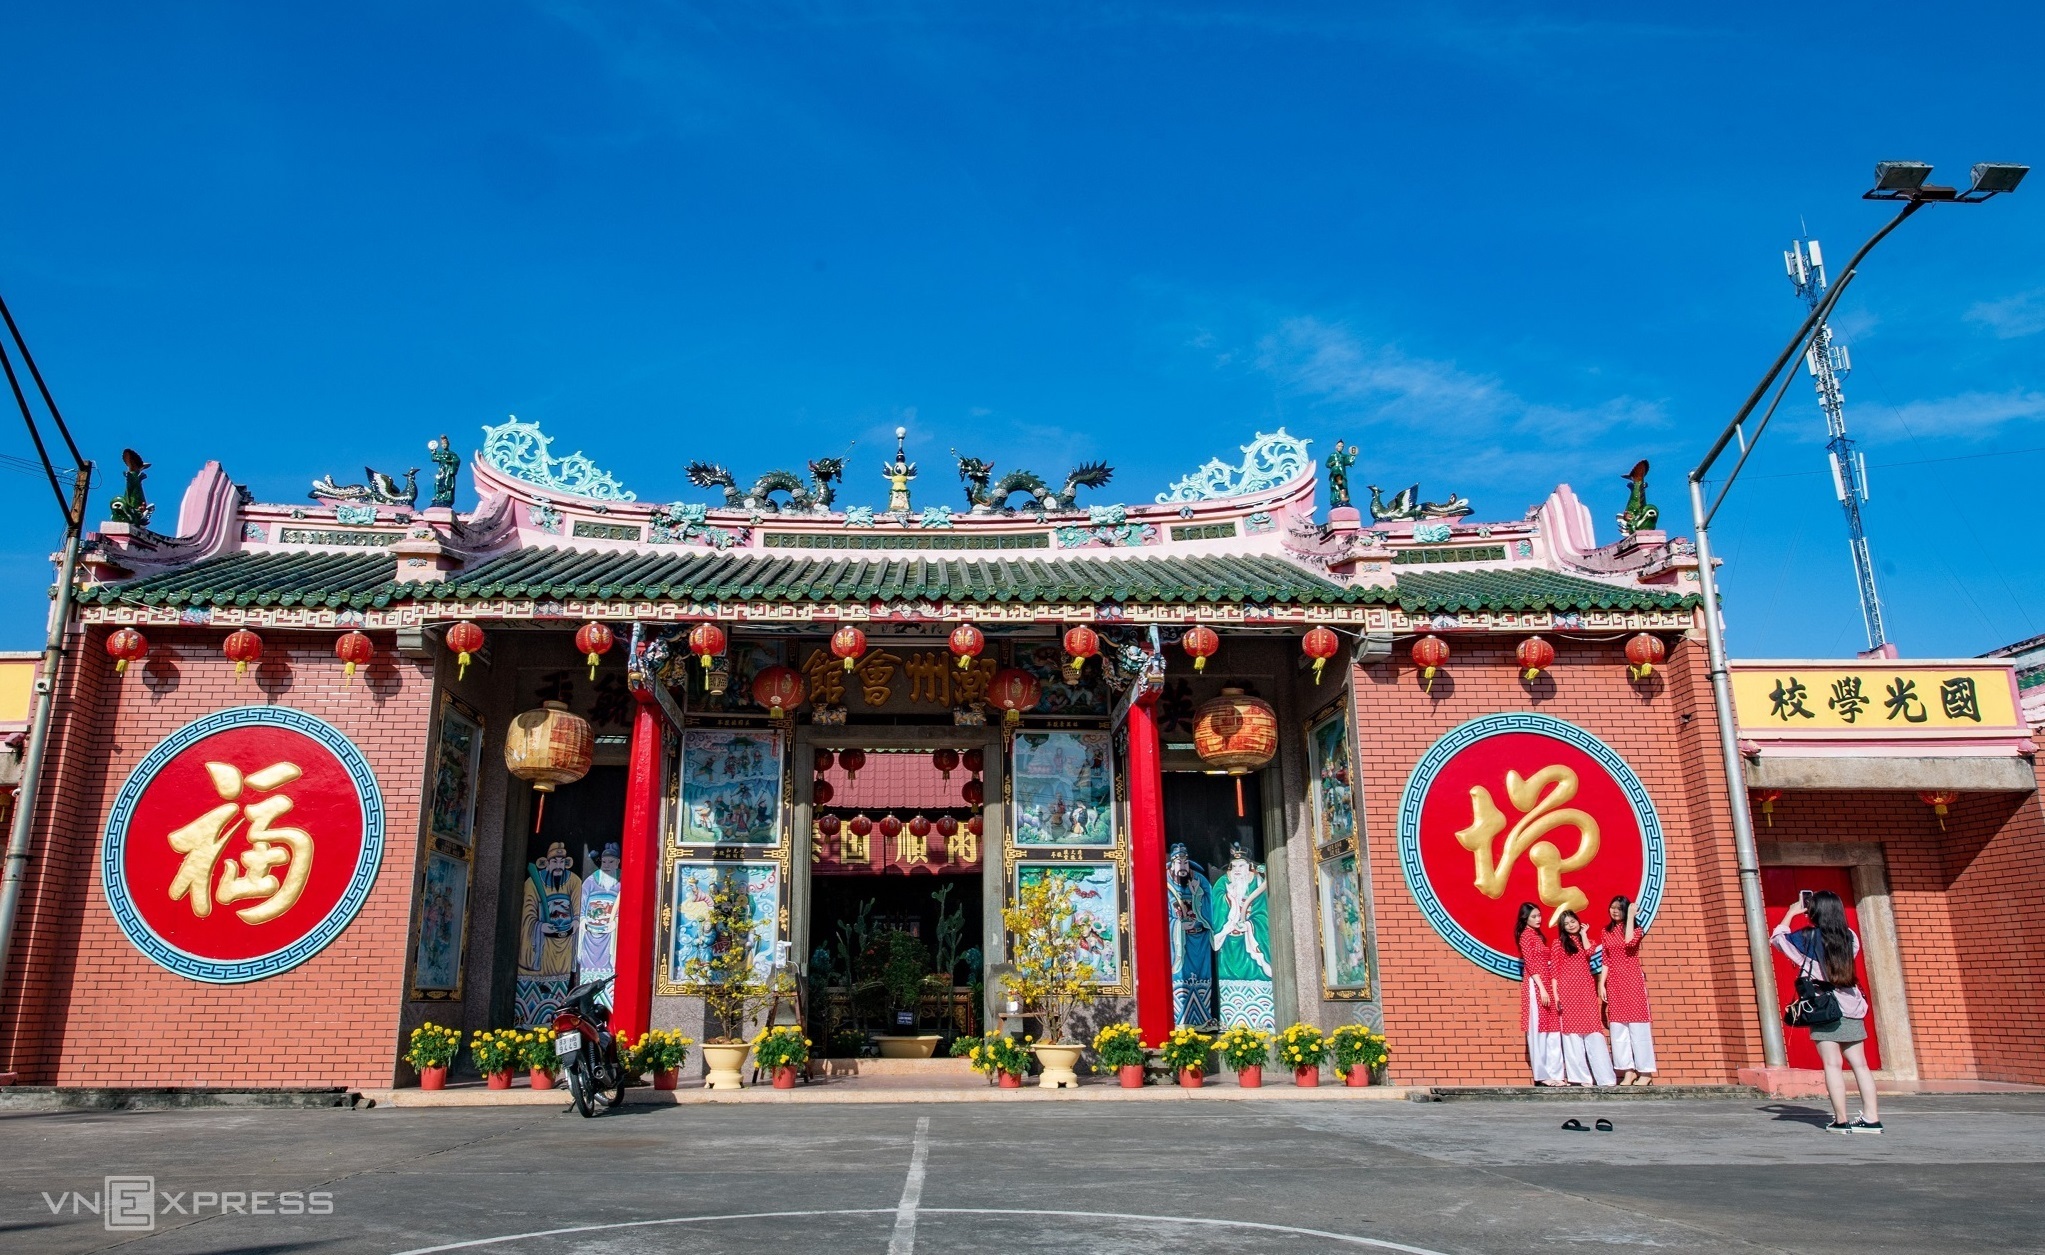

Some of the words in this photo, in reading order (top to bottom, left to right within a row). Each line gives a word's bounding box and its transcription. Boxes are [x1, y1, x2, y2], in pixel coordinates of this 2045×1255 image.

[802, 649, 999, 708] 潮州會館
[1768, 676, 1982, 724] 國光學校
[167, 761, 315, 926] 福
